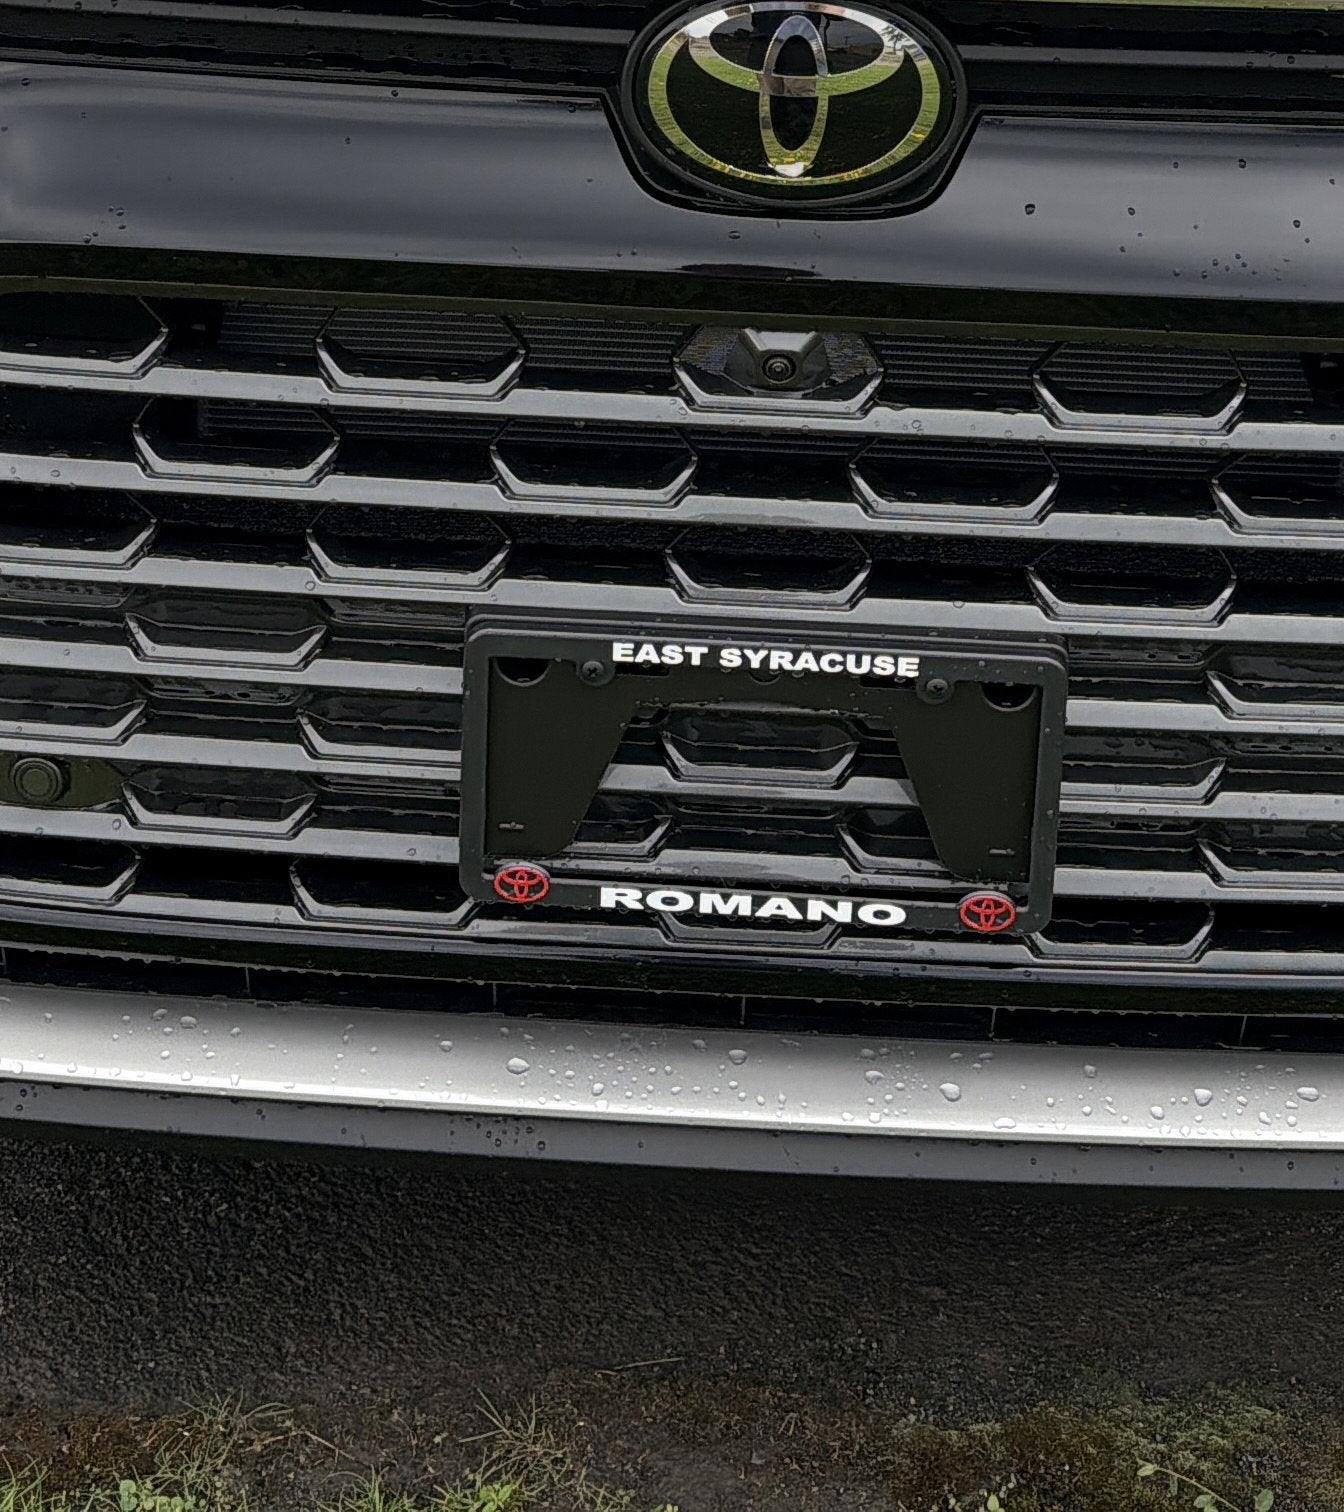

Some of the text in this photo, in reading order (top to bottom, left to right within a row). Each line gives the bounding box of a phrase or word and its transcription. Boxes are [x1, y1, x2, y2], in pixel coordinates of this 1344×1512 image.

[612, 643, 920, 678] EAST SYRACUSE
[600, 886, 907, 926] ROMANO
